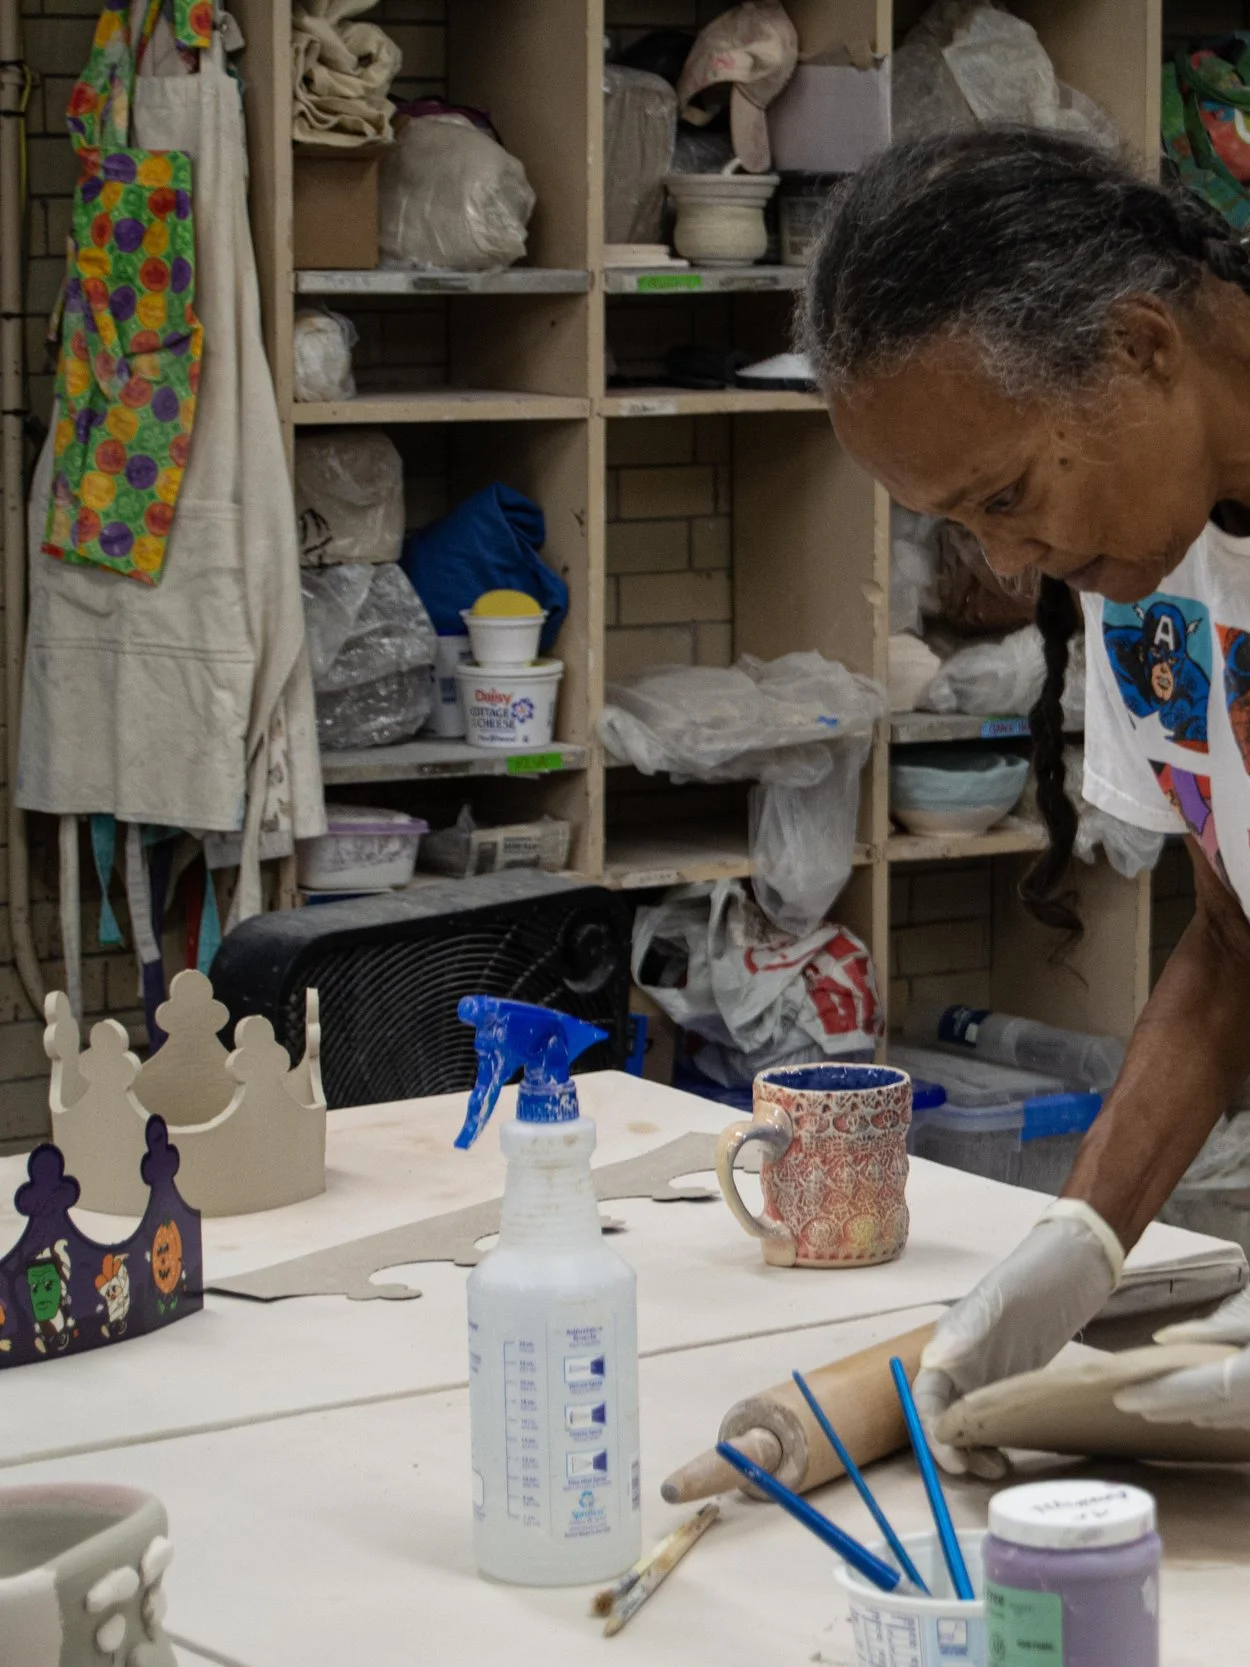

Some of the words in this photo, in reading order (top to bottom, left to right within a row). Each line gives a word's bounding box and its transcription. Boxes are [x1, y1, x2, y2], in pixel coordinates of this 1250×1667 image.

[1153, 614, 1175, 651] A
[474, 687, 513, 705] Daisy
[470, 706, 510, 718] COTTAGE
[478, 718, 515, 729] CHEESE
